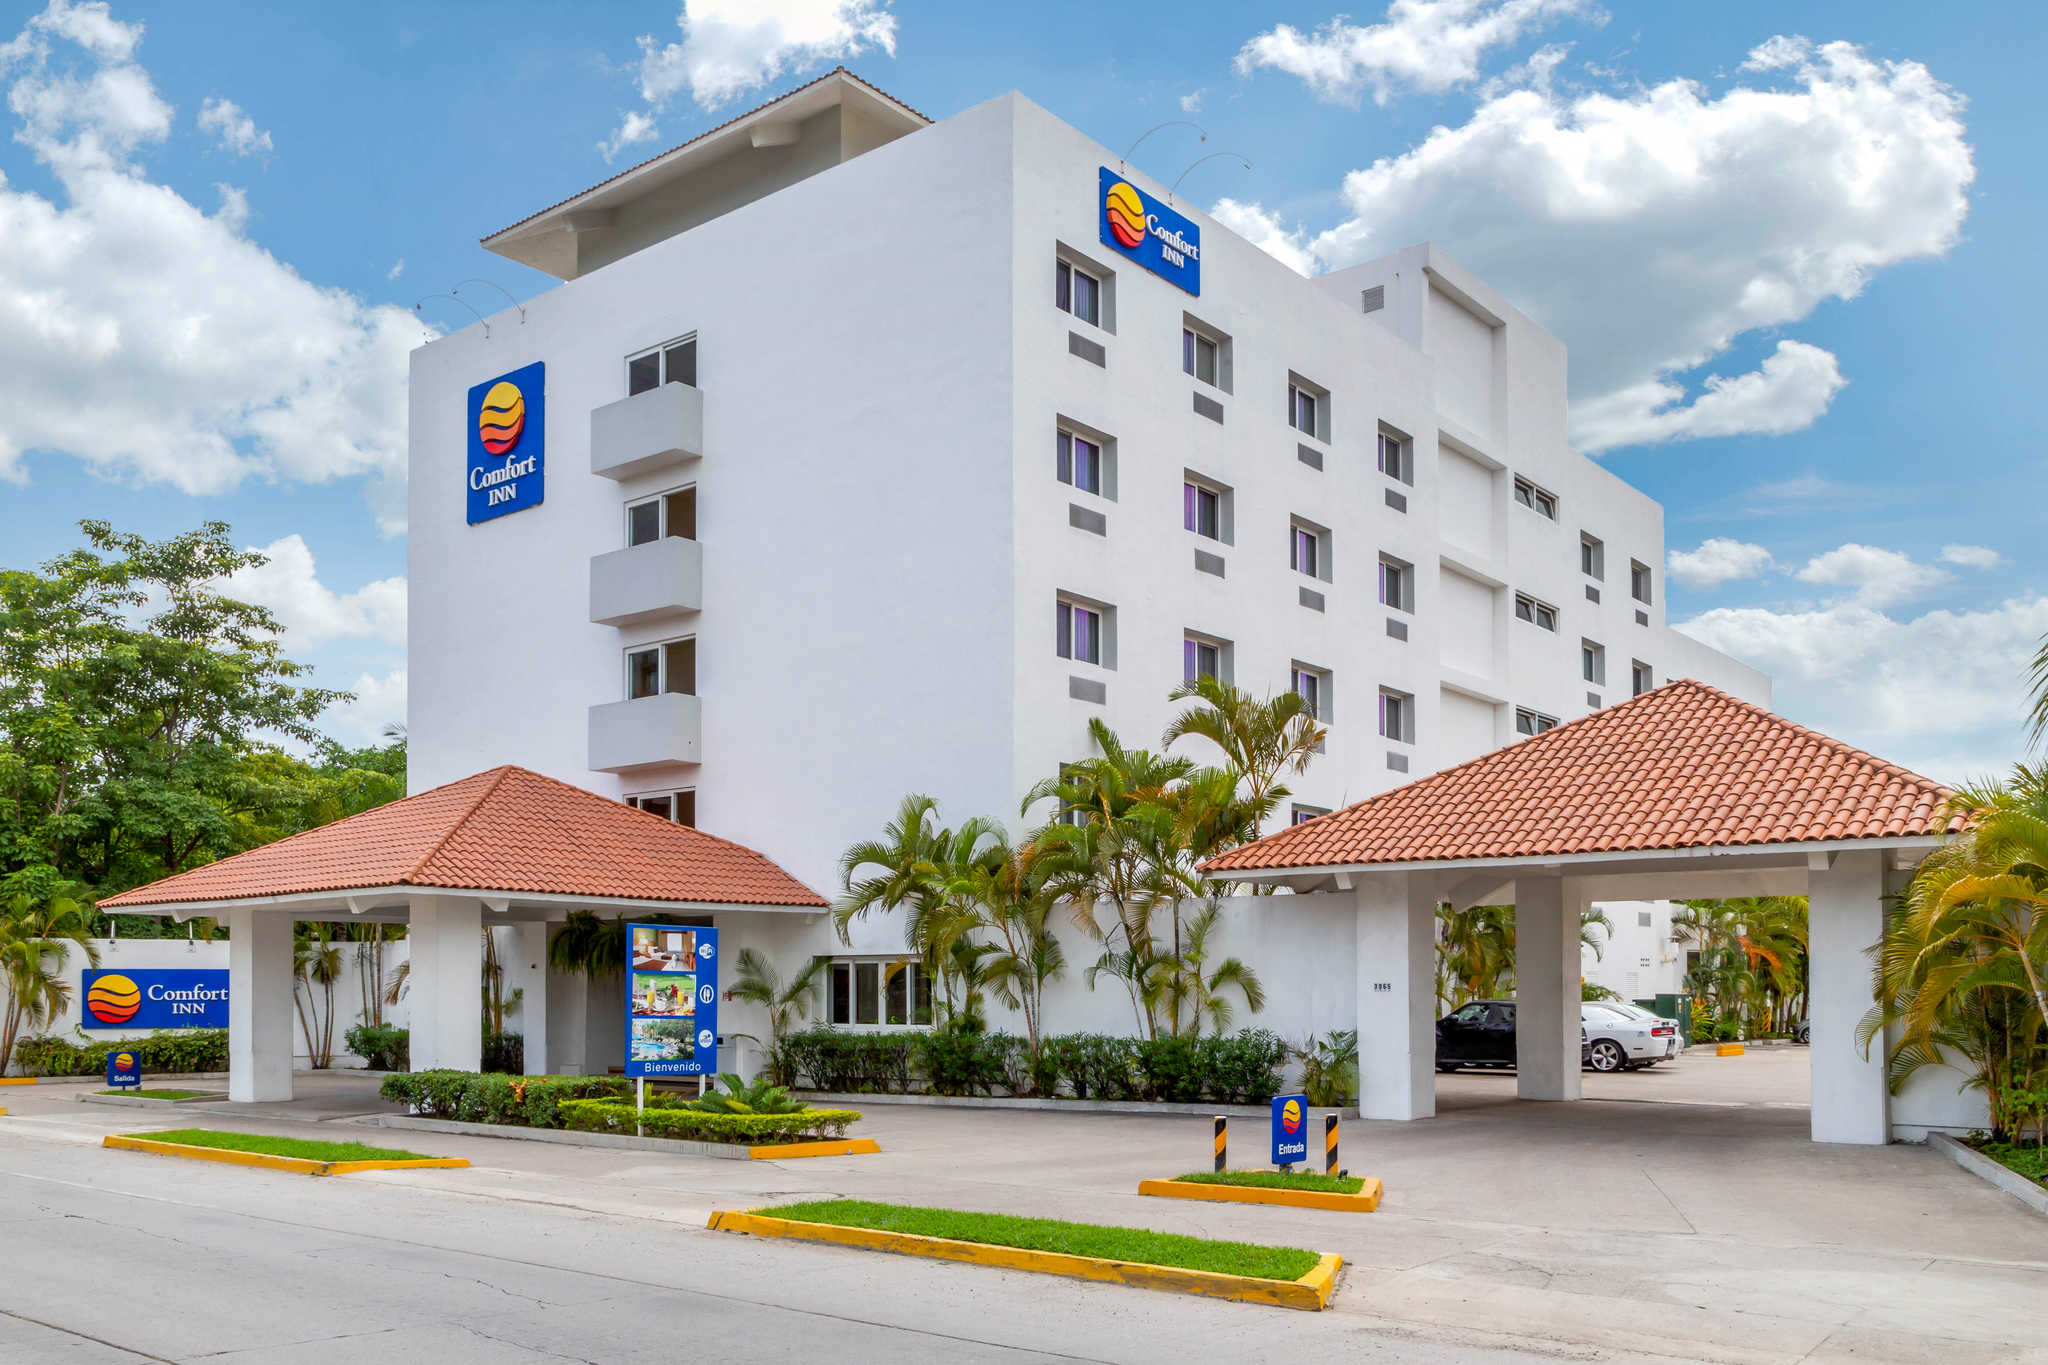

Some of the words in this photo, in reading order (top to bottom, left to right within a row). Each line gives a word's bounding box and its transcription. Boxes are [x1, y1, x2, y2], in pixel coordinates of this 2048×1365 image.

[1146, 214, 1199, 261] Comfort
[1161, 244, 1185, 269] INN
[470, 454, 537, 491] Comfort
[488, 483, 517, 507] INN
[147, 983, 229, 1002] Comfort
[172, 1002, 206, 1015] INN
[644, 1061, 702, 1073] Bienvenido
[113, 1074, 136, 1082] Salida
[1279, 1141, 1305, 1155] Entrada
